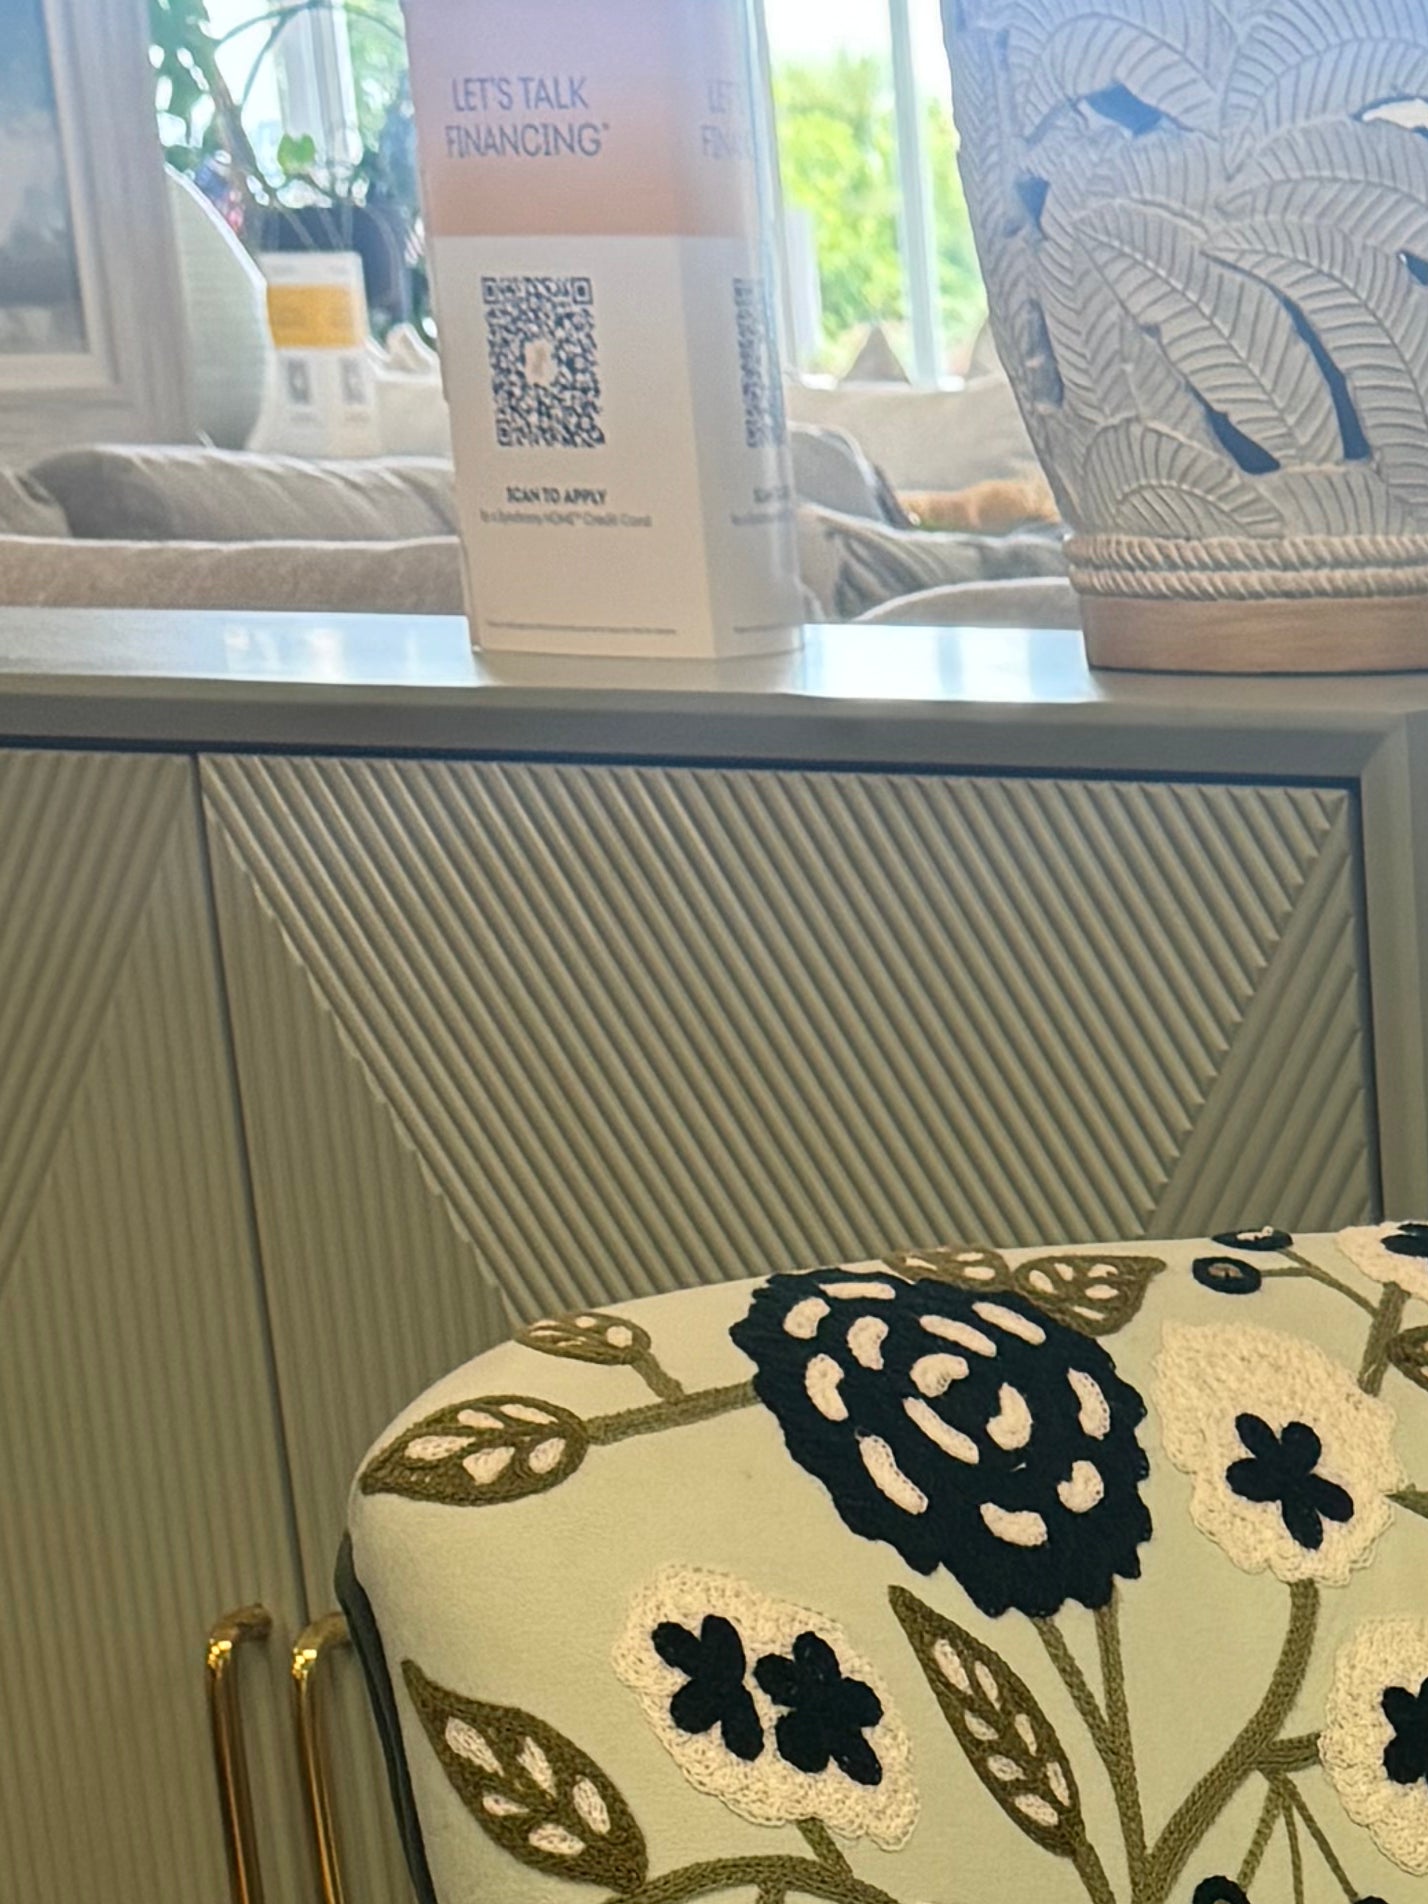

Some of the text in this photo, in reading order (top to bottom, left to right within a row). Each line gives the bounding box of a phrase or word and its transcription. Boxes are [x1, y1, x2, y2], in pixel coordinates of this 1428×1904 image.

[451, 75, 589, 112] LET'S TALK
[506, 485, 607, 505] SCAN TO APPLY
